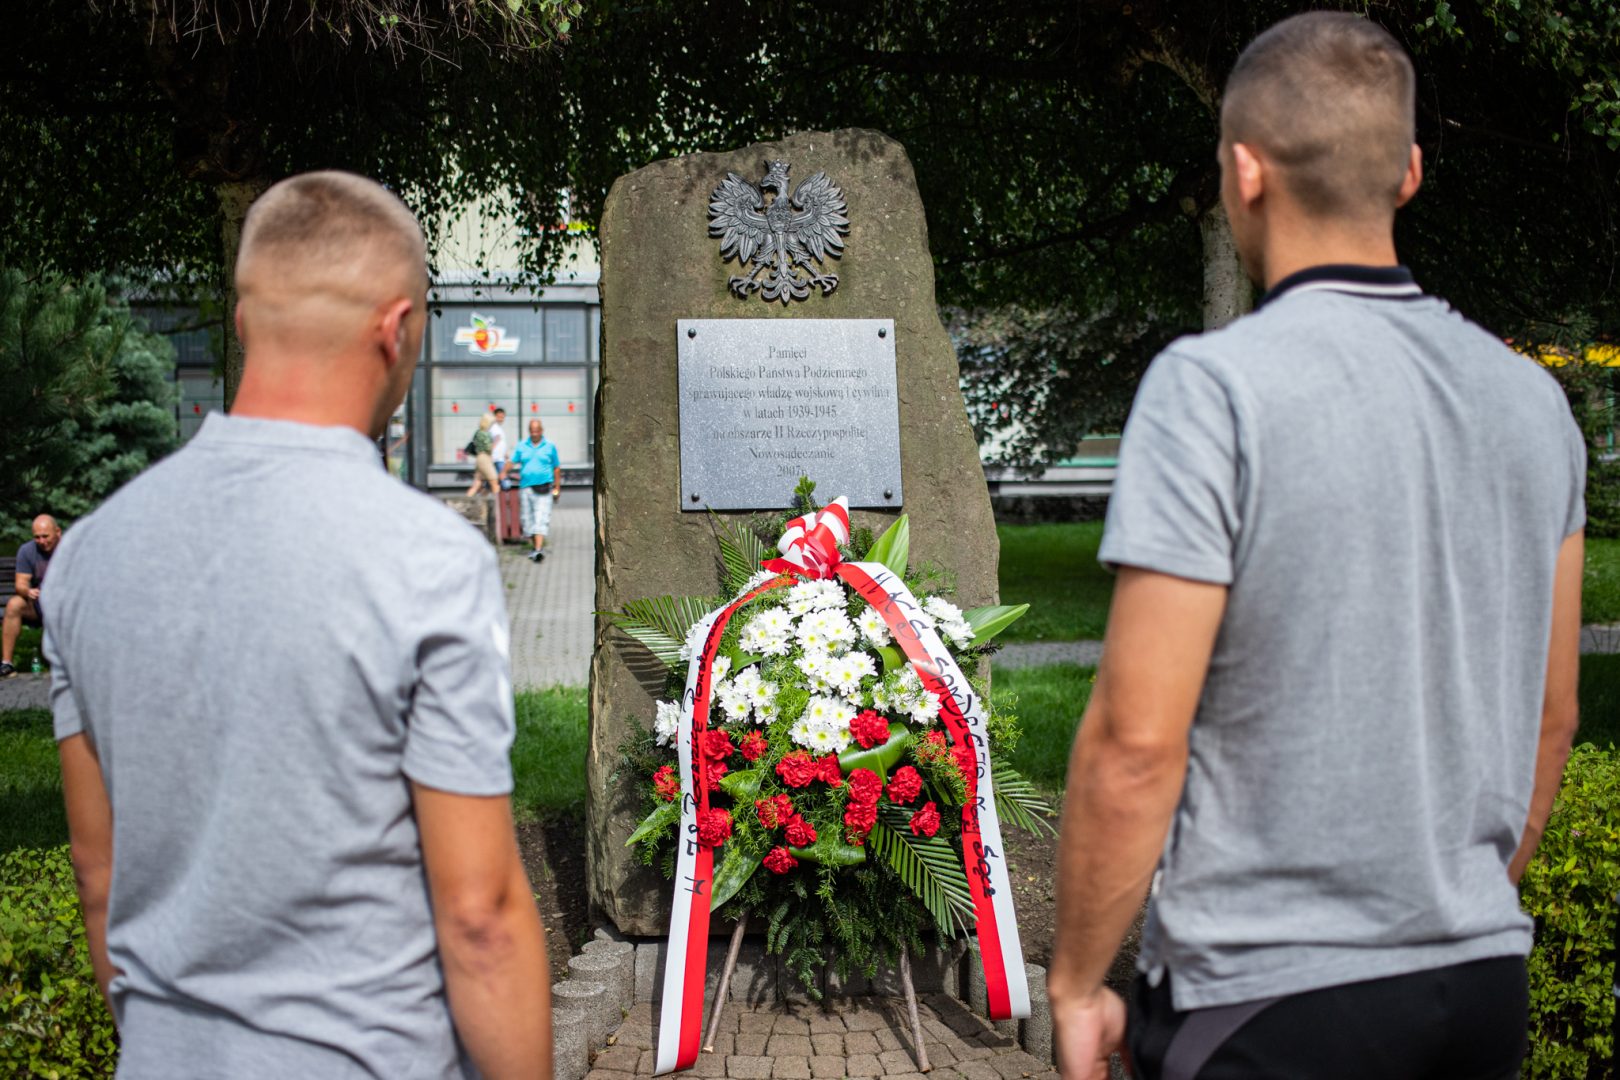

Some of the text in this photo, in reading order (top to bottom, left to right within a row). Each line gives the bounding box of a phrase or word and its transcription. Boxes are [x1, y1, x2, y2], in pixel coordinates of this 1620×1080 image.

[768, 345, 807, 361] Pamięci
[709, 365, 868, 380] Polskiego Państwa Podziemnego
[758, 385, 792, 401] władzę
[794, 386, 844, 402] wojskową
[755, 405, 785, 419] latach
[787, 404, 838, 419] 1939-1945
[786, 424, 869, 441] Rzeczypospolitej
[748, 446, 836, 461] Nowosądeczanie
